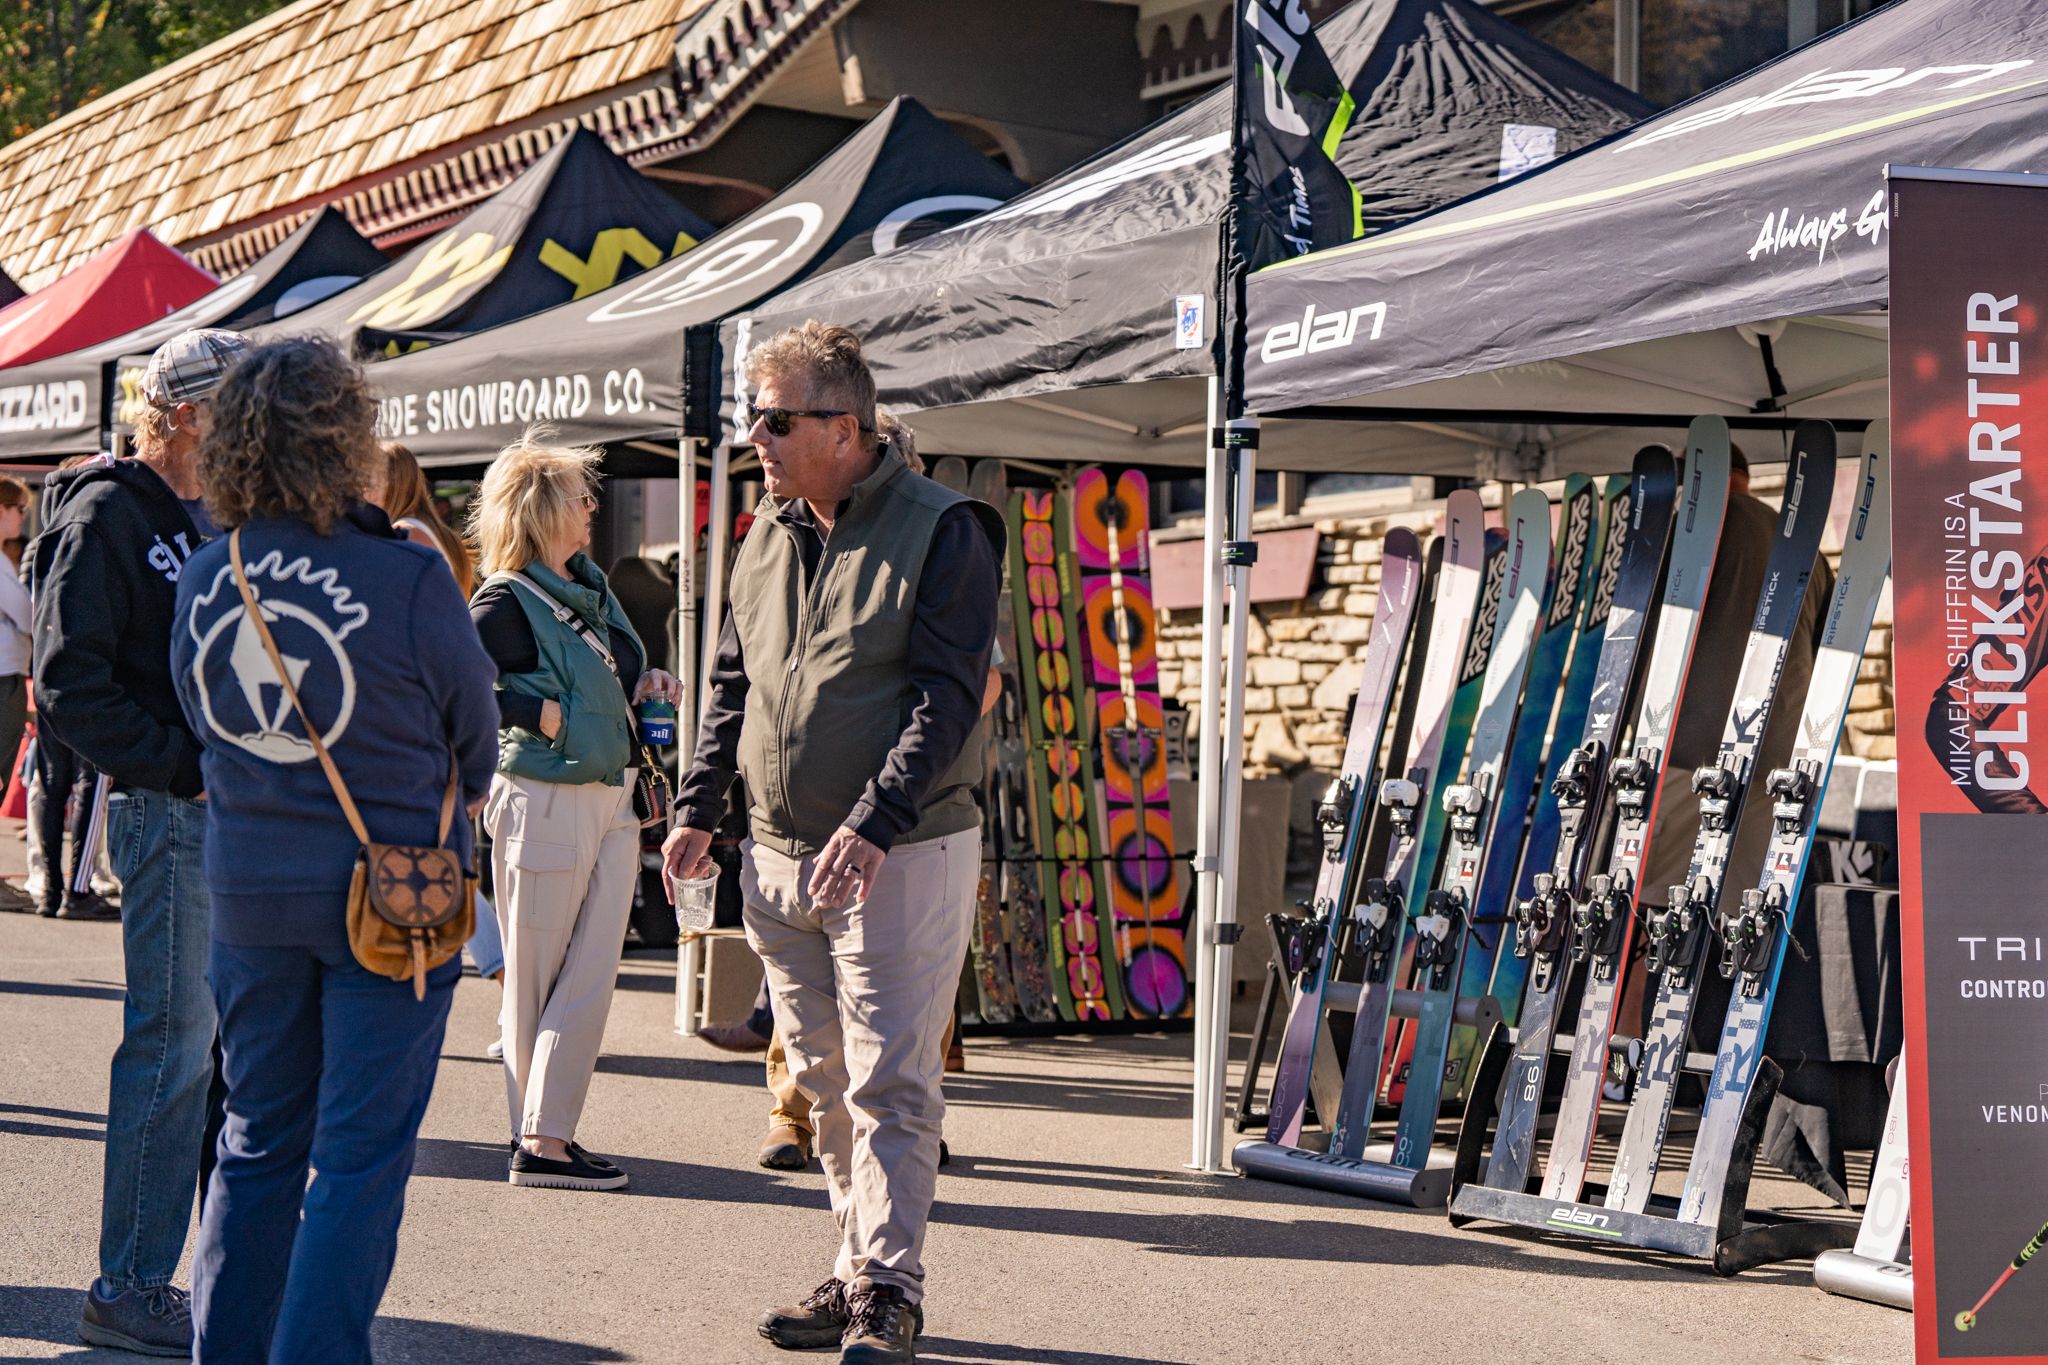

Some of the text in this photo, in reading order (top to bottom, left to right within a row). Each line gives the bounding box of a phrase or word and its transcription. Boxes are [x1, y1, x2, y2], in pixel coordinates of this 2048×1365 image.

[1288, 165, 1312, 231] Times
[1746, 206, 1849, 267] Always
[1261, 301, 1387, 363] elan
[427, 374, 591, 433] SNOWBOARD
[604, 367, 656, 416] CO.
[1633, 475, 1645, 530] elan
[1685, 448, 1703, 533] elan
[1784, 451, 1807, 538] elan
[1855, 453, 1877, 541] elan
[1508, 518, 1525, 600] elan
[1966, 292, 2029, 791] CLICKSTARTER
[1401, 555, 1413, 606] elan
[1826, 575, 1851, 645] RIPSTICK
[1944, 492, 1971, 786] MIKAELA SHIFFRIN IS A
[1960, 979, 2048, 998] CONTRO
[1524, 1065, 1541, 1101] 86
[1551, 1206, 1610, 1228] elan
